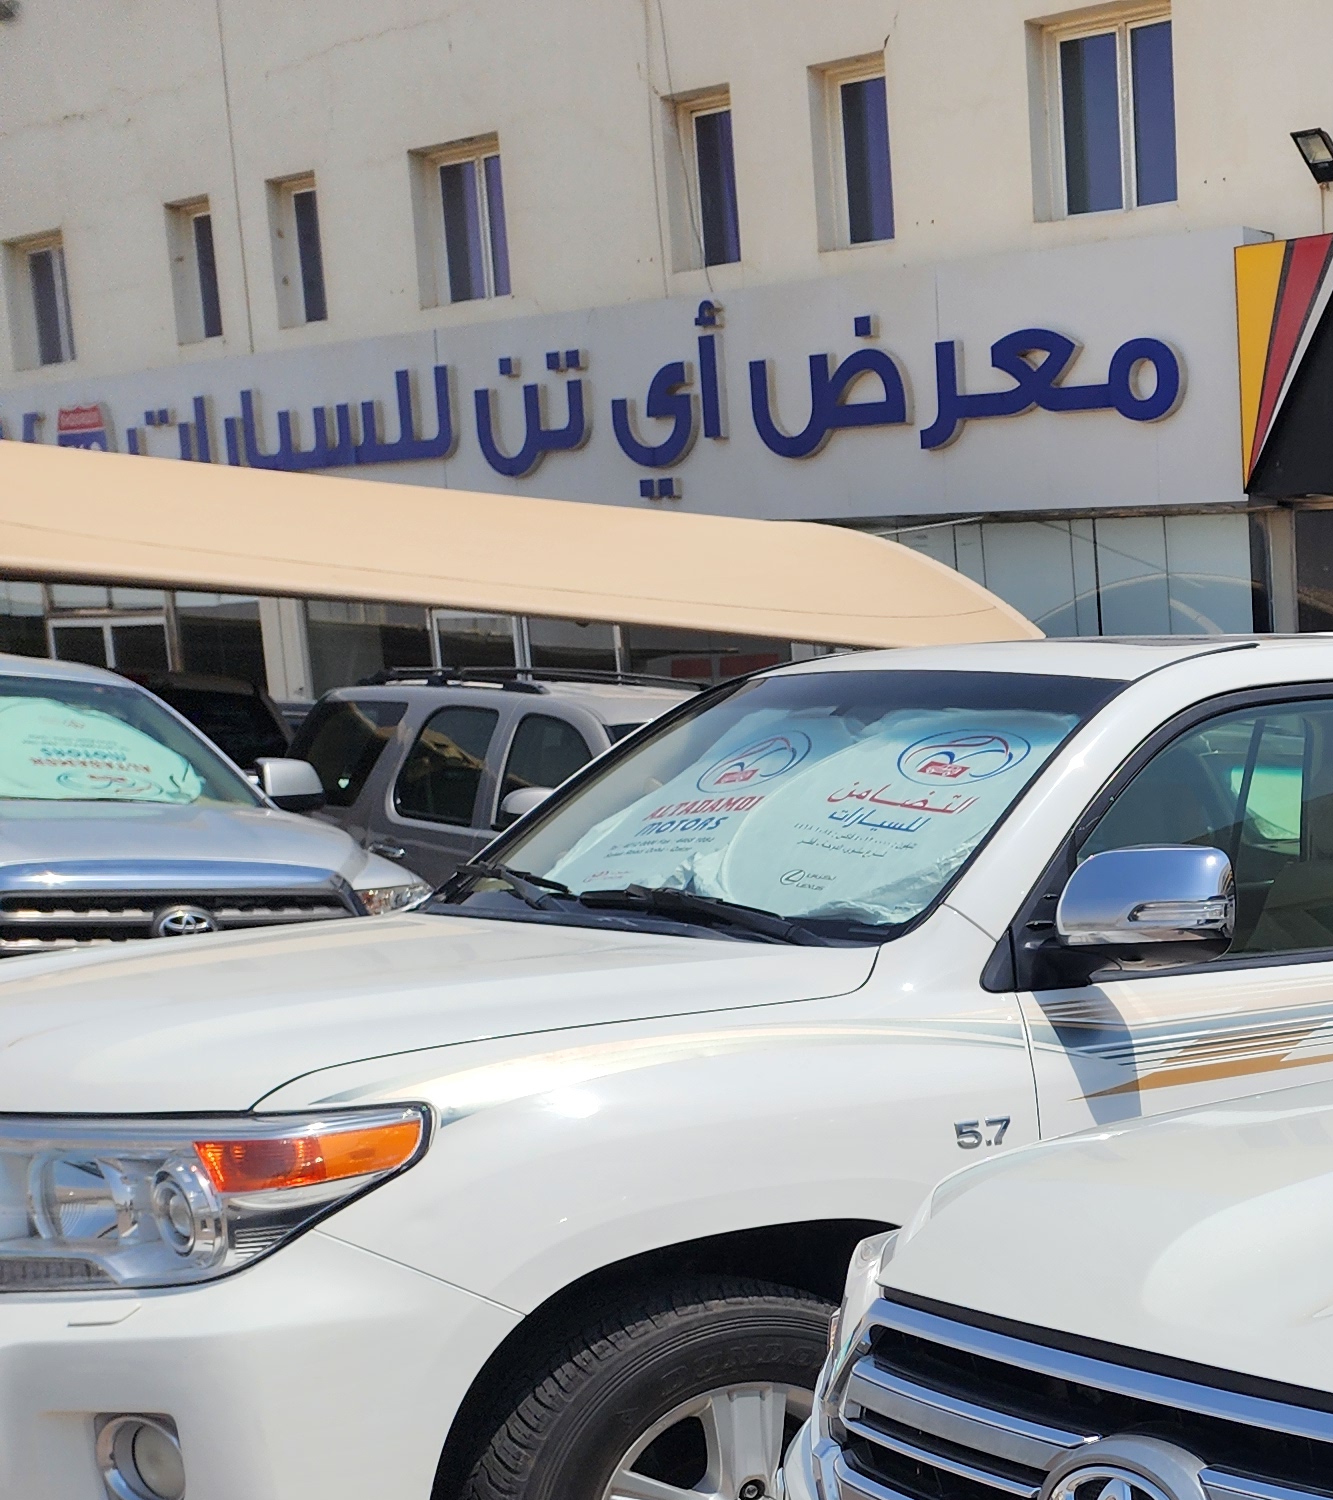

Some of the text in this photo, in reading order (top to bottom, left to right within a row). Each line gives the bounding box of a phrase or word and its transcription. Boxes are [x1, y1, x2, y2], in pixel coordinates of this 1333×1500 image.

[612, 299, 729, 500] أي
[749, 314, 1184, 459] معرض
[475, 349, 588, 477] تن
[828, 781, 981, 815] التضامن
[828, 806, 931, 833] للسيارات
[634, 816, 729, 838] MOTORS
[954, 1115, 1011, 1150] 5.7
[659, 1341, 822, 1398] DUNLO
